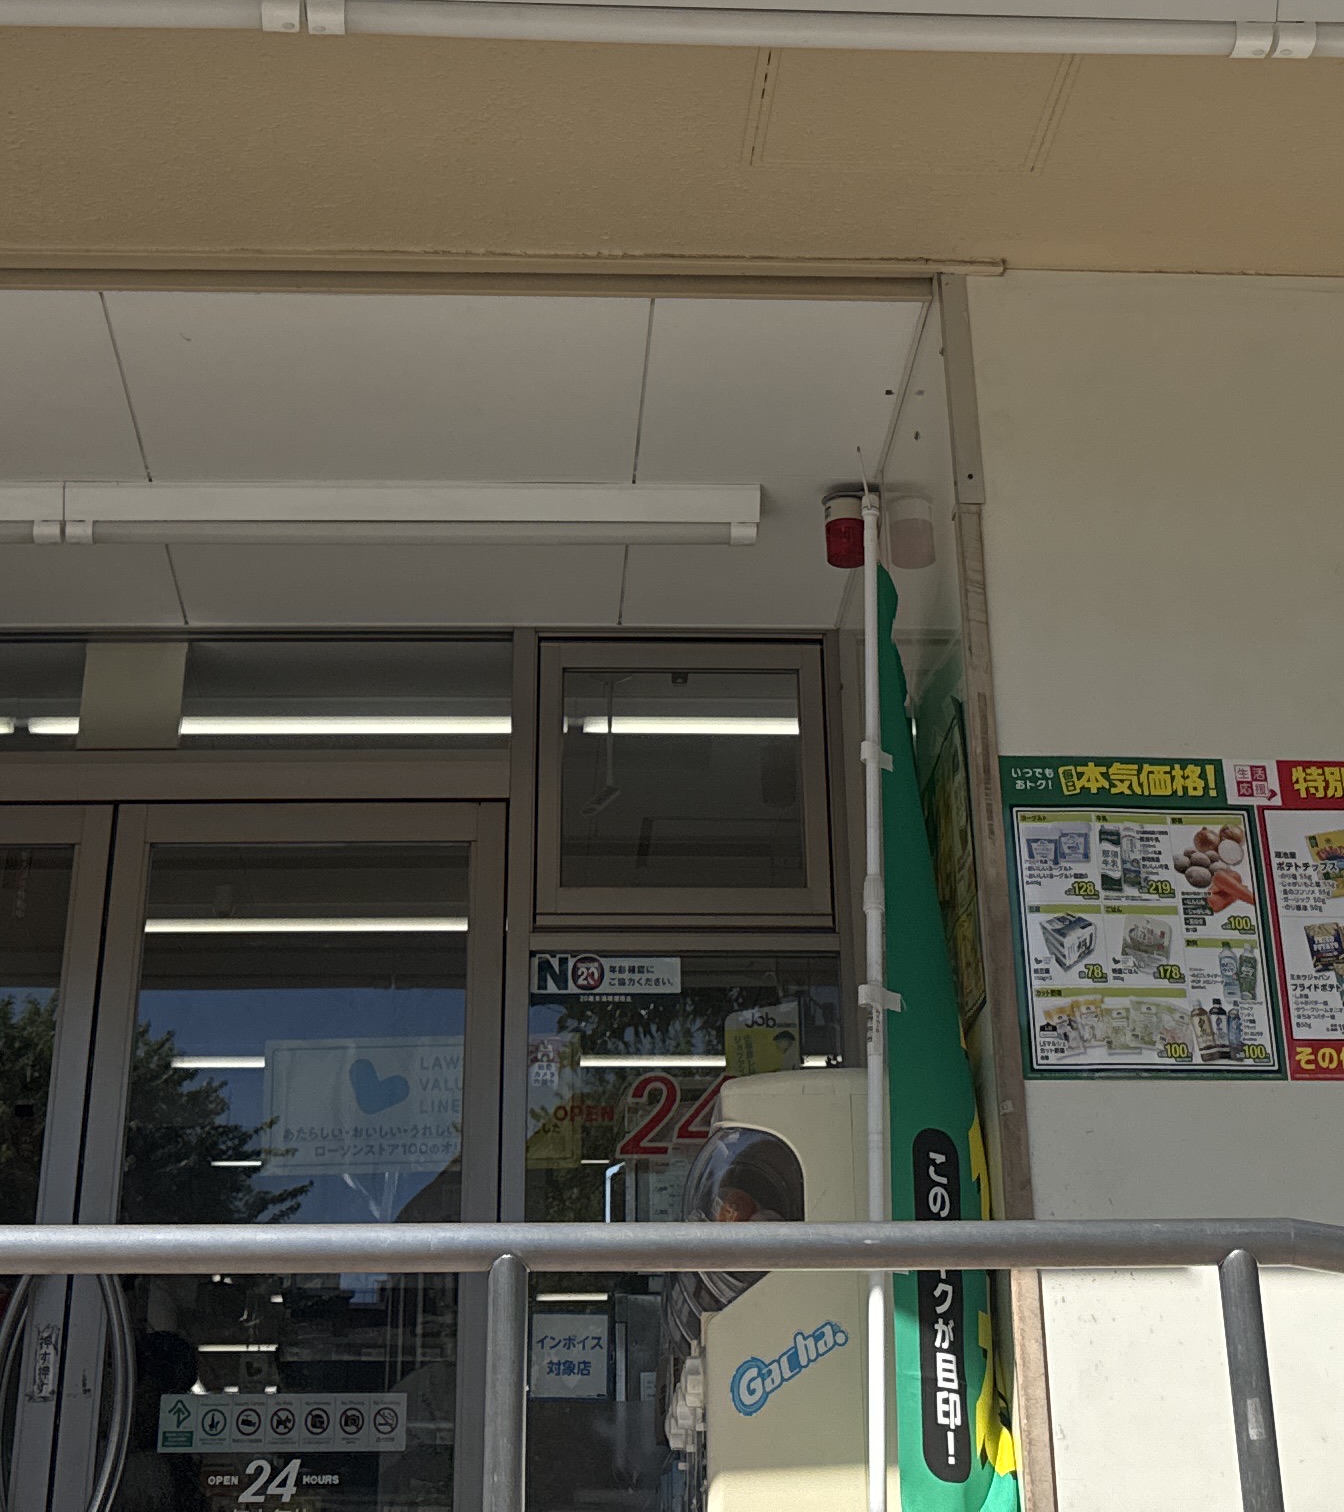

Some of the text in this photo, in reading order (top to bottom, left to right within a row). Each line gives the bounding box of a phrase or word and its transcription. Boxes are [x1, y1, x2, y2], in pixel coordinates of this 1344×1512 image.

[1011, 768, 1054, 778] いつでも
[1075, 762, 1217, 797] 本気価格!
[1235, 766, 1266, 780] 生活
[1277, 861, 1337, 872] ポテトチップス
[609, 978, 675, 987] ご協力ください。
[1290, 983, 1341, 992] フライドポテト
[745, 1011, 776, 1028] Job
[420, 1056, 464, 1071] LAW
[553, 1106, 614, 1123] OPEN
[929, 1152, 962, 1466] このクが目印!
[536, 1335, 604, 1351] インボイス
[547, 1360, 591, 1376] 対象店
[207, 1458, 340, 1504] OPEN 24 HOURS
